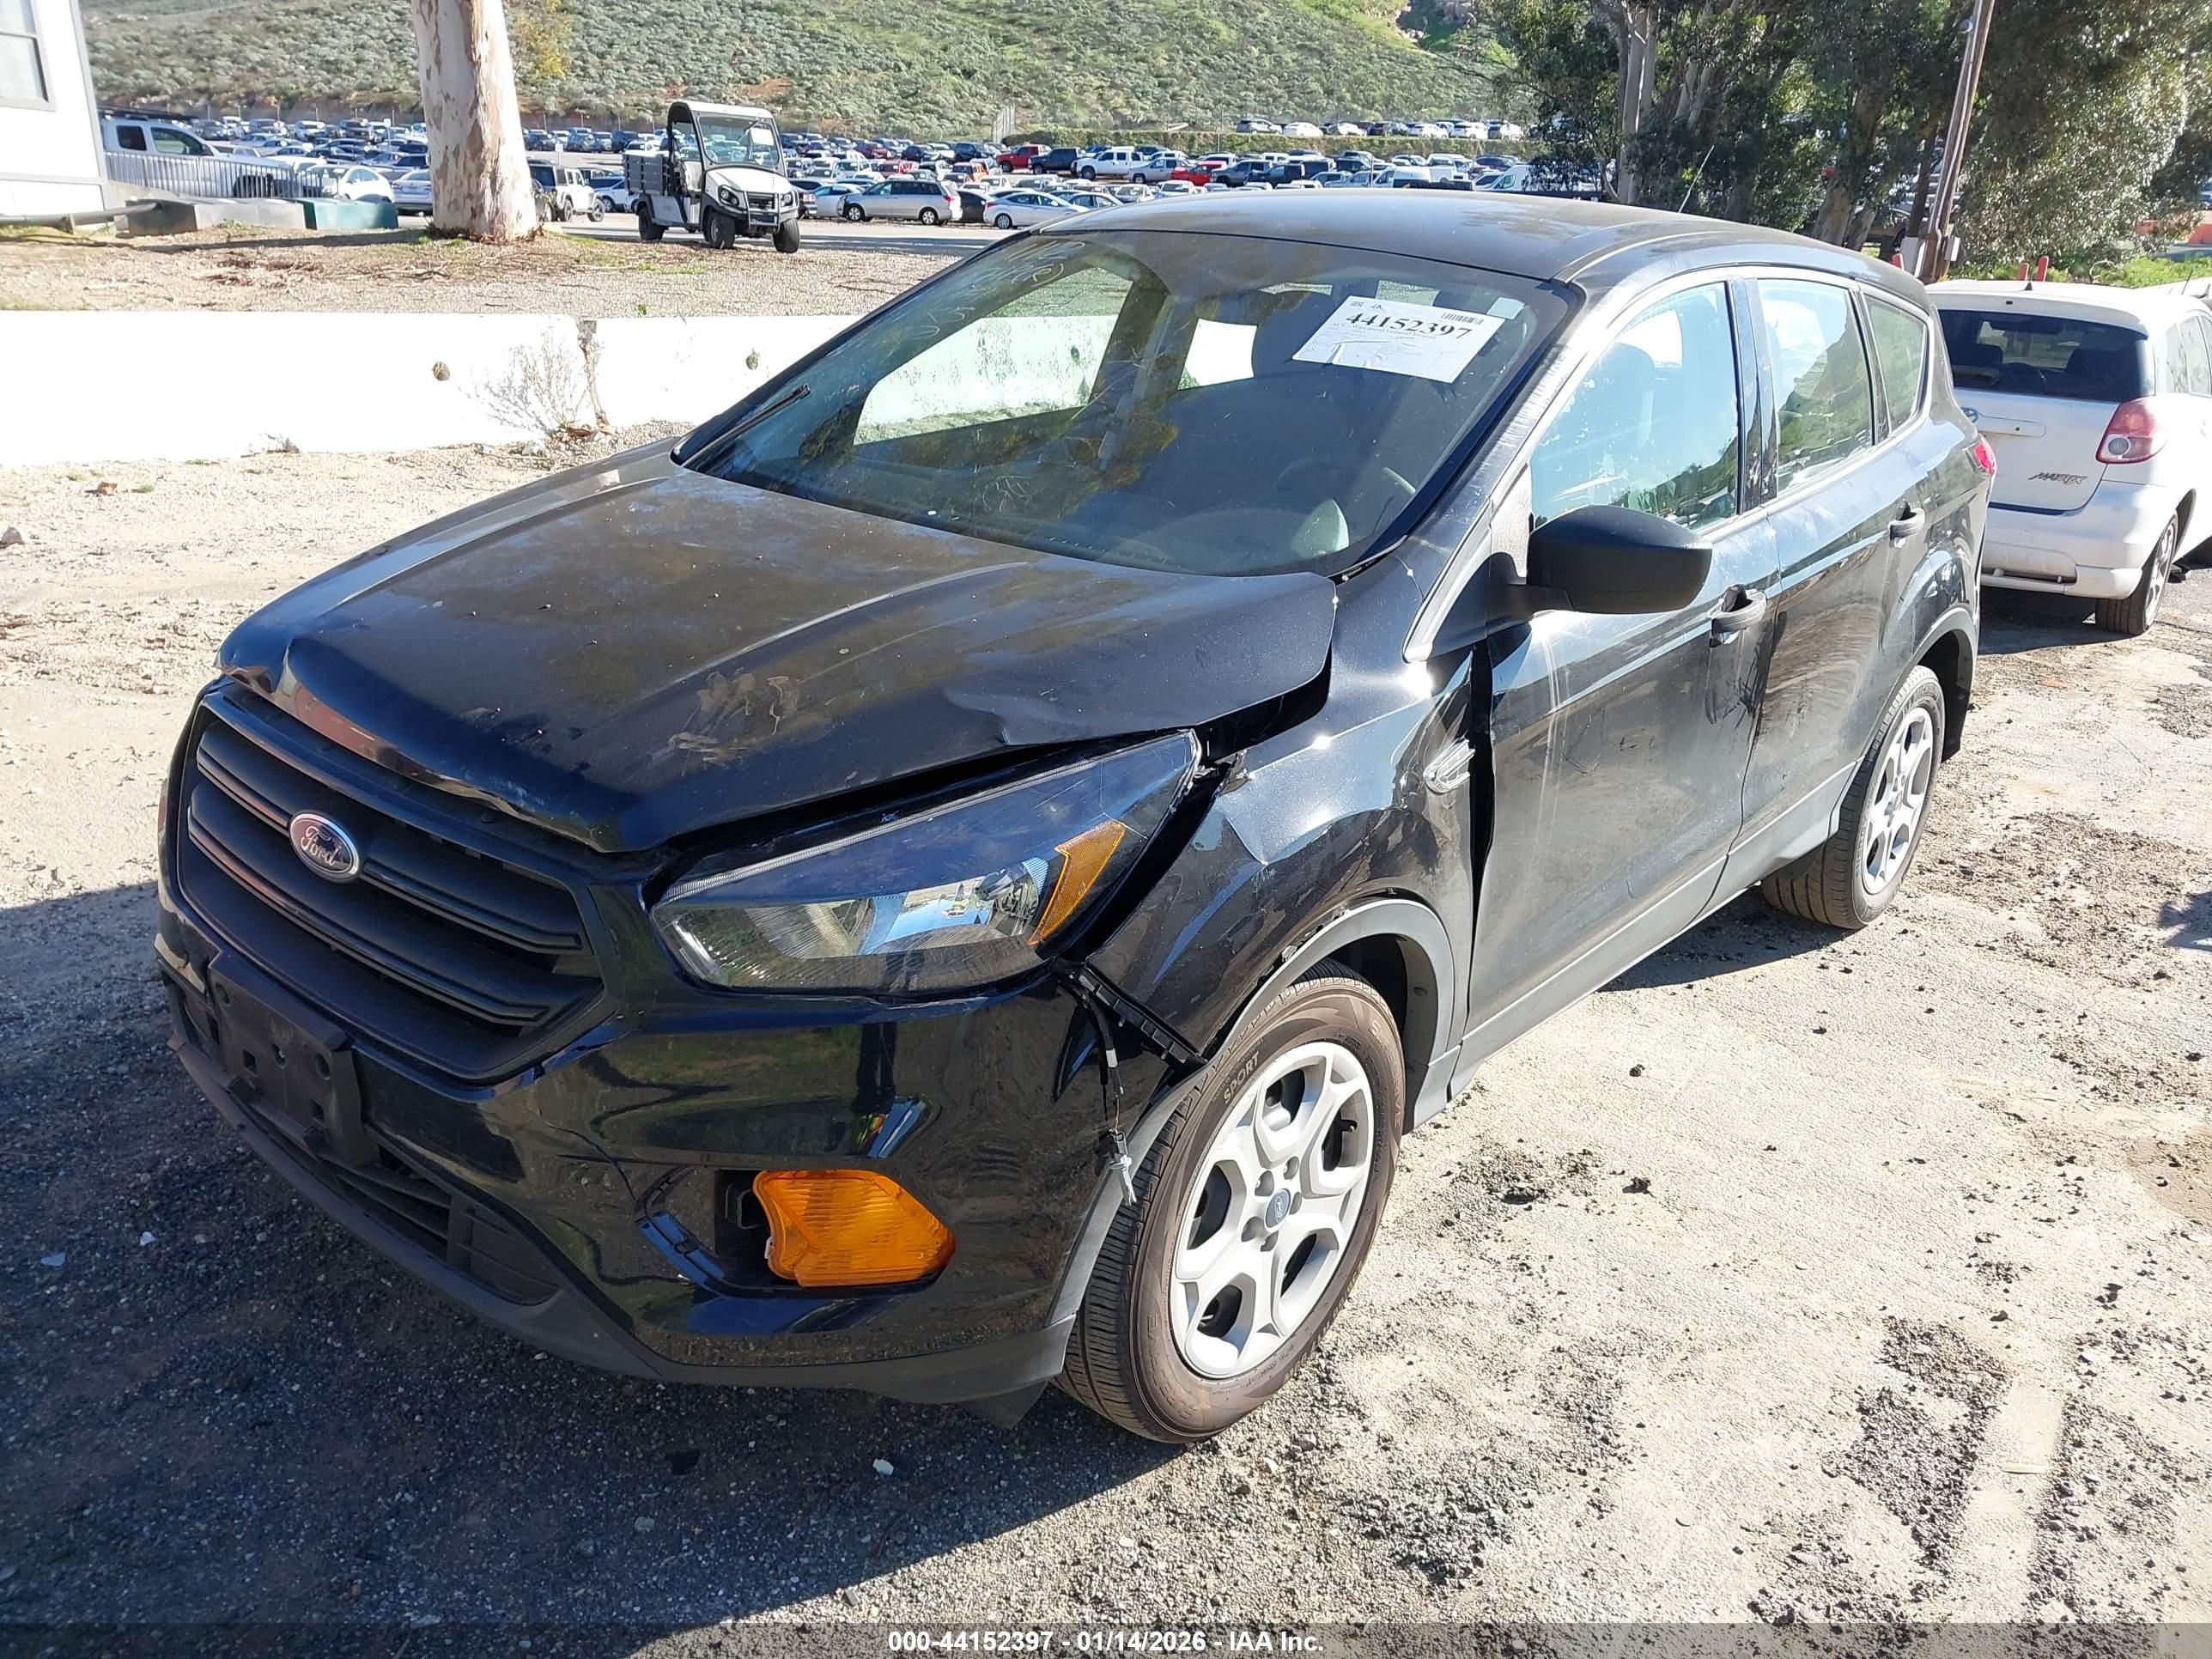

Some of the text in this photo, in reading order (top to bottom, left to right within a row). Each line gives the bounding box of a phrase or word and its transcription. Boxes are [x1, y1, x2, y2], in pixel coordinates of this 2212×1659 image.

[1346, 313, 1474, 339] 44152397
[2027, 471, 2088, 485] MATRIX
[301, 825, 338, 866] Ford
[1223, 1050, 1260, 1105] SPORT
